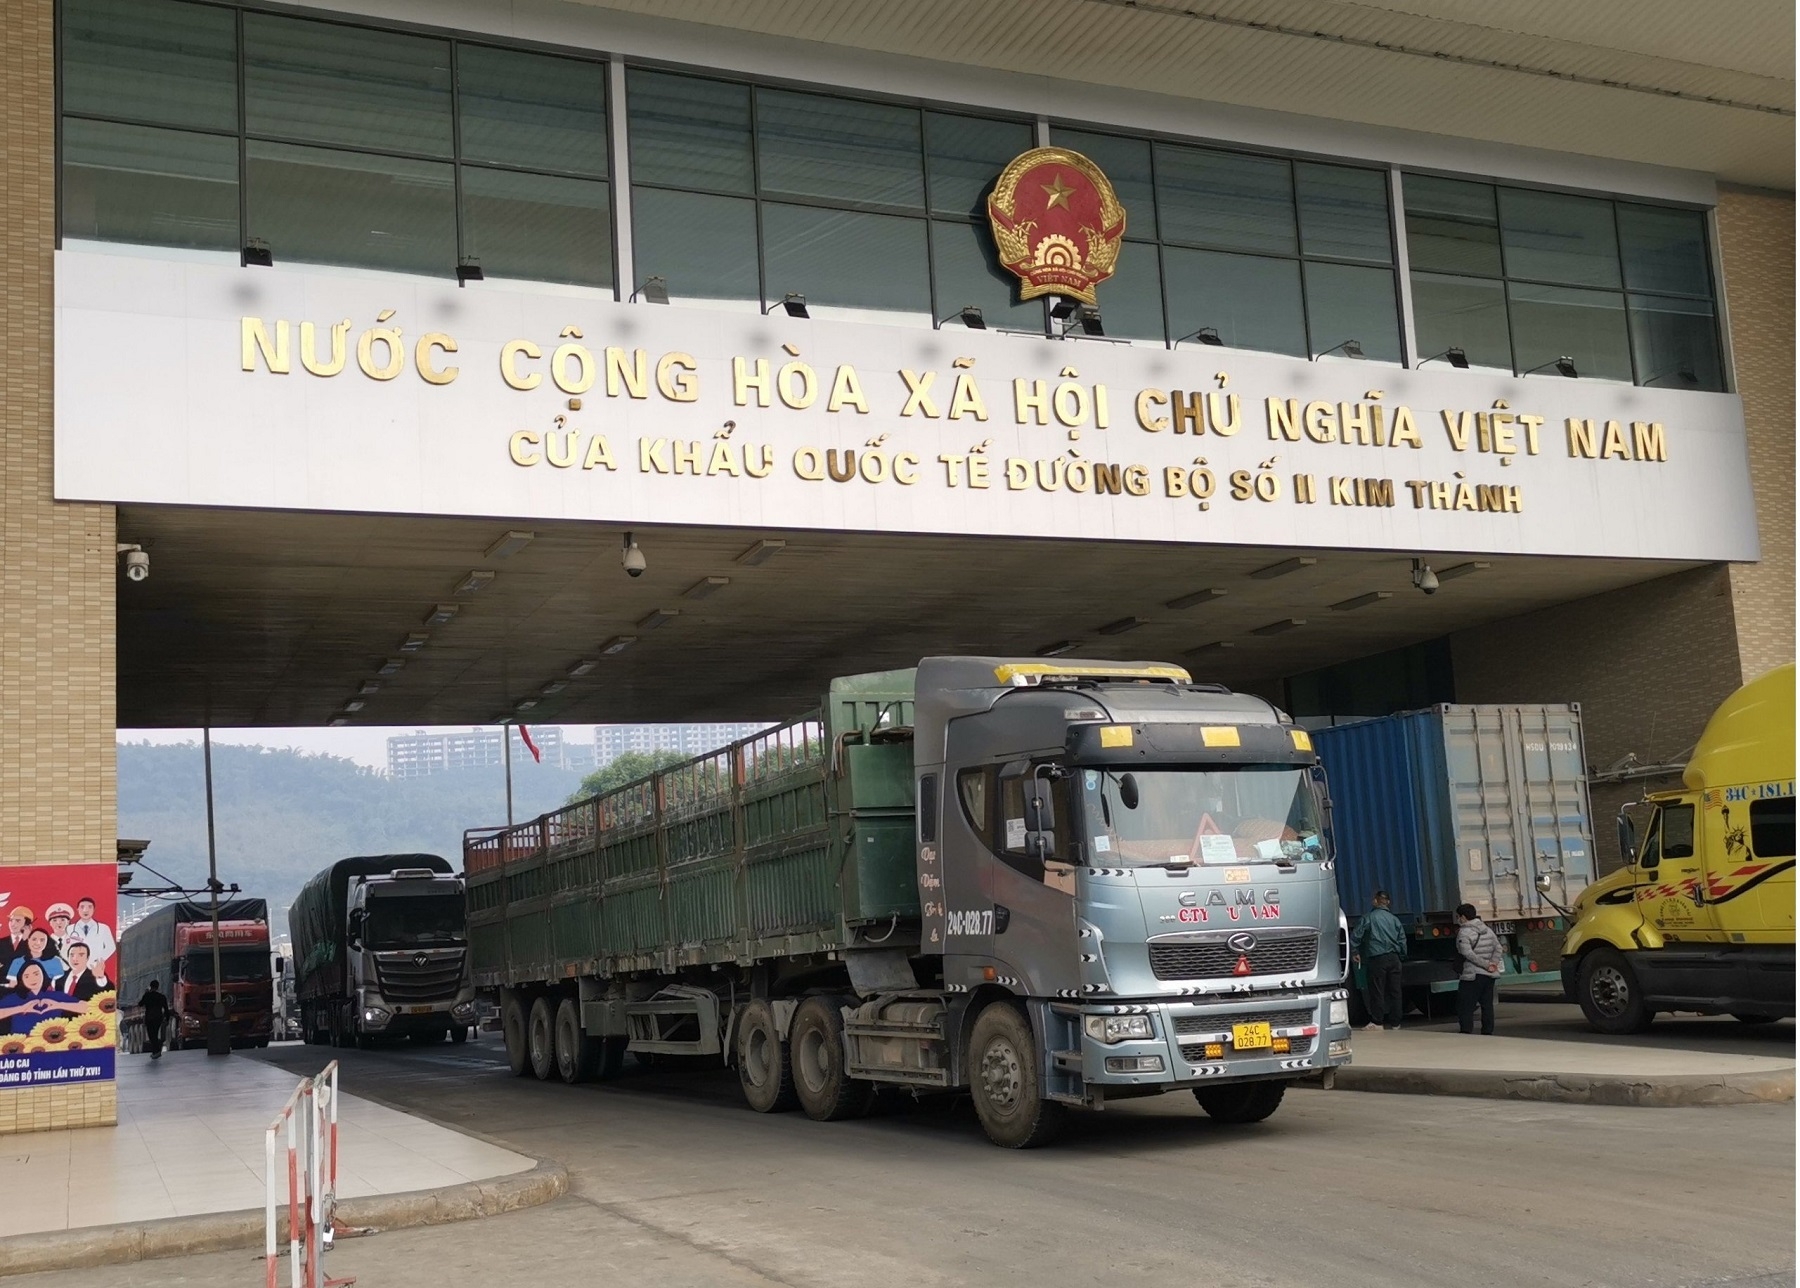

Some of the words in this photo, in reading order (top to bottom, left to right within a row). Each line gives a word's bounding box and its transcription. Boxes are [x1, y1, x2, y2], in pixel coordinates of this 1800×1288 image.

[241, 309, 459, 385] NƯỚC
[500, 325, 698, 411] CỘNG
[732, 343, 869, 414] HÒA
[898, 357, 988, 421] XÃ
[1013, 366, 1110, 440] HỘI
[1136, 371, 1242, 436] CHỦ
[1266, 389, 1423, 448] NGHĨA
[1440, 399, 1544, 466] VIỆT
[1564, 417, 1668, 462] NAM
[509, 415, 617, 471] CỬA
[639, 420, 773, 478] KHẨU
[793, 433, 920, 485] QUỐC
[938, 438, 993, 488] TẾ
[1004, 449, 1151, 495] ĐƯỜNG
[1163, 457, 1216, 511] BỘ
[1230, 456, 1281, 502] SỐ
[1293, 473, 1317, 504] II
[1329, 476, 1395, 507] KIM
[1405, 471, 1523, 513] THÀNH
[1178, 889, 1280, 906] CAMC
[947, 910, 993, 935] 24C-028.77
[1243, 1025, 1260, 1036] 24C
[1238, 1035, 1267, 1048] 028.77
[0, 1058, 14, 1069] LÀO
[16, 1058, 30, 1068] CAI
[21, 1069, 31, 1082] BỘ
[85, 1066, 100, 1076] XVI!
